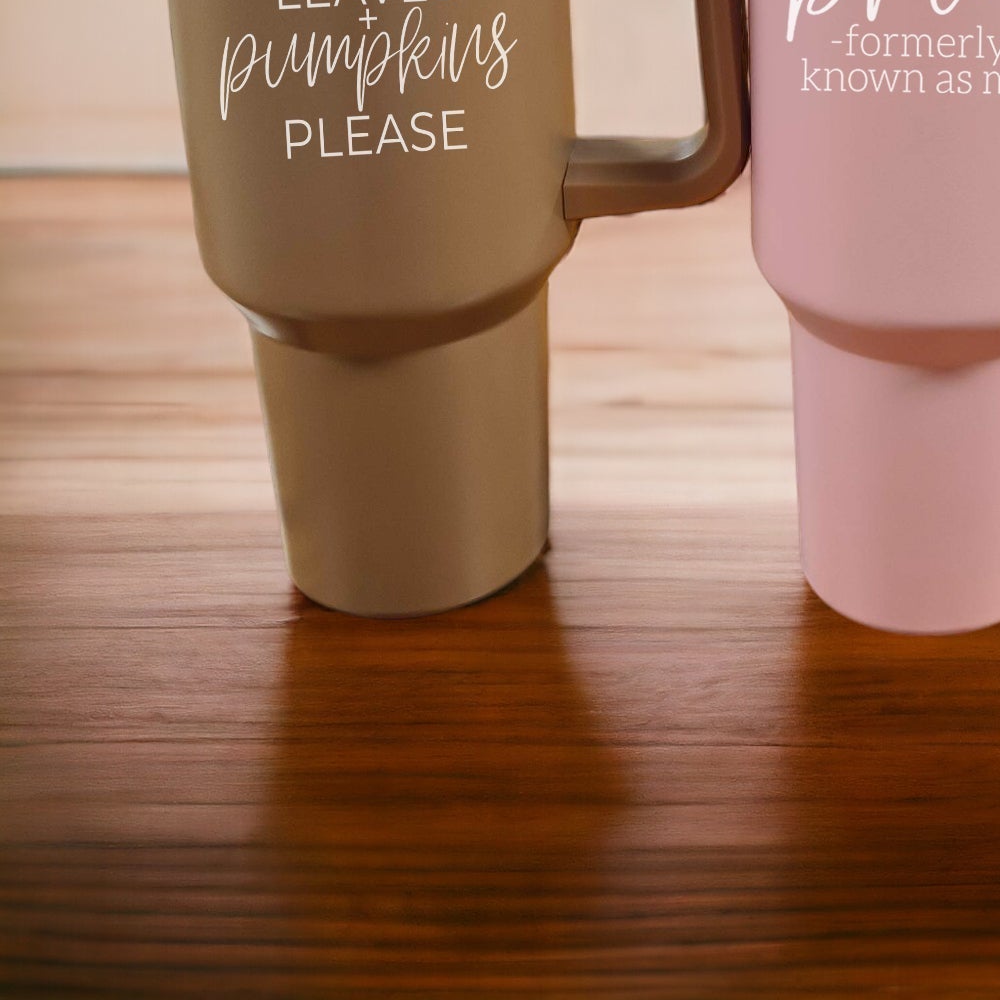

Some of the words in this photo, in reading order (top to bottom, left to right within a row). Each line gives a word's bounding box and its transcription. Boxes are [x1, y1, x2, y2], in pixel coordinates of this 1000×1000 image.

[219, 6, 518, 121] pumpkins
[800, 58, 926, 93] known
[936, 69, 973, 94] as
[285, 109, 468, 159] PLEASE
